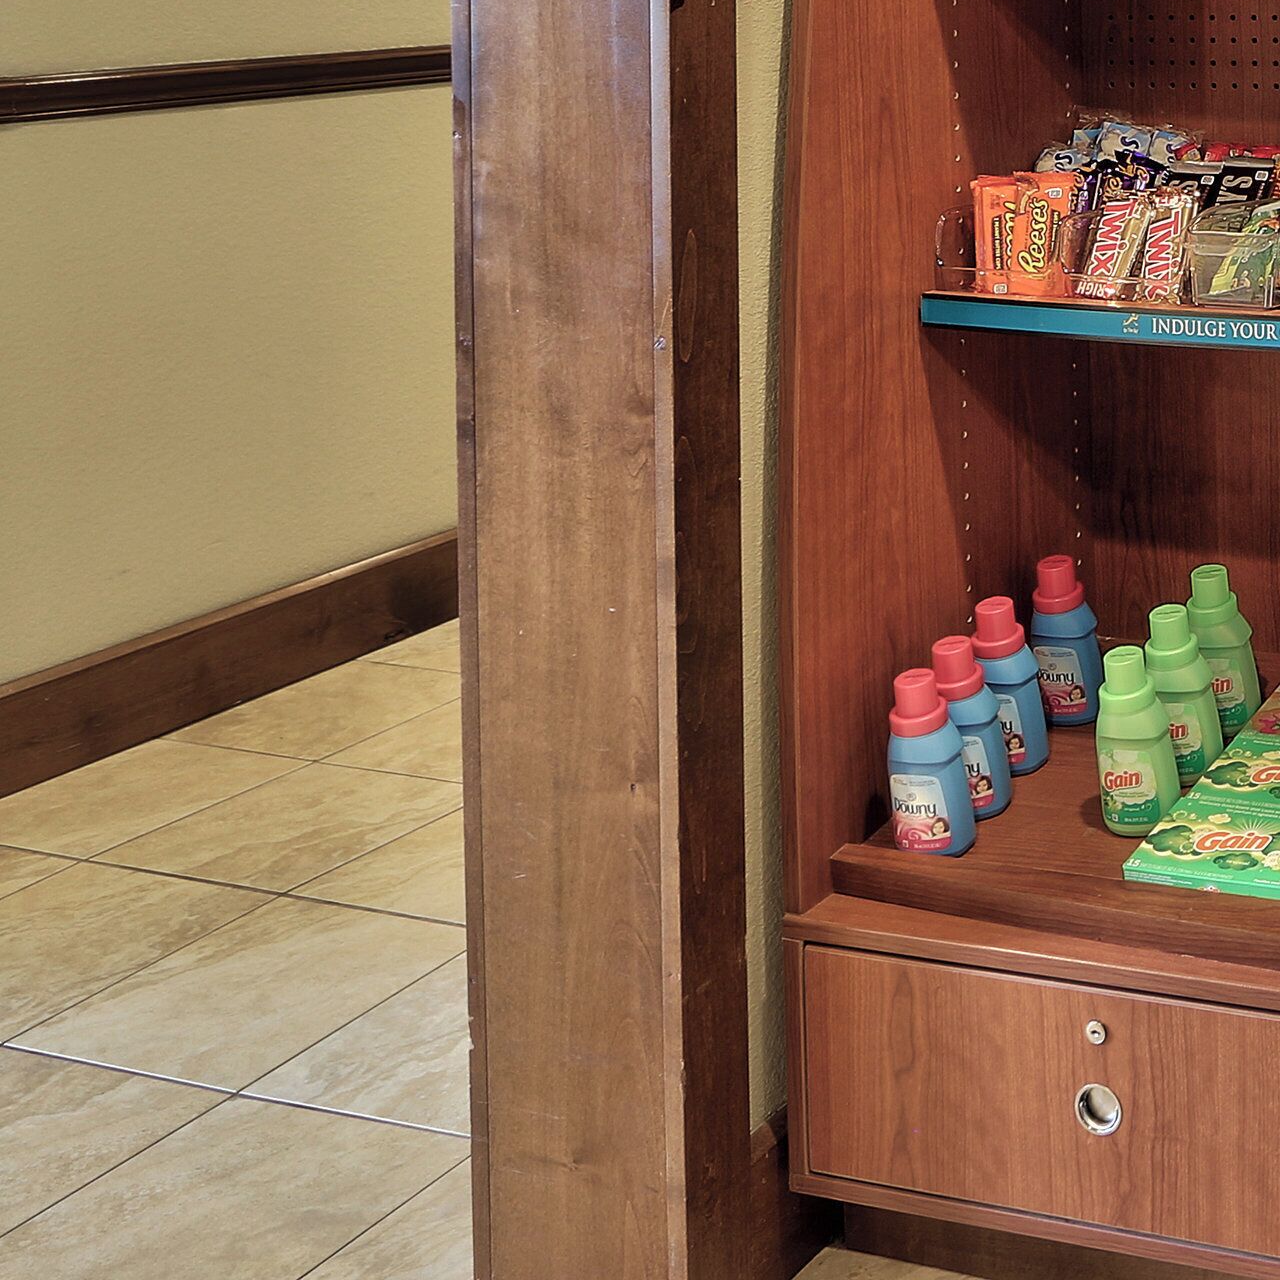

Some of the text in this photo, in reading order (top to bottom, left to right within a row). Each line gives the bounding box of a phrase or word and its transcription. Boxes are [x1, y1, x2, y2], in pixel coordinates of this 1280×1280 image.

[1151, 317, 1226, 337] INDULGE
[1229, 321, 1278, 341] YOUR
[1103, 770, 1143, 790] Gain
[893, 797, 938, 818] Downy
[1195, 830, 1274, 853] Gain
